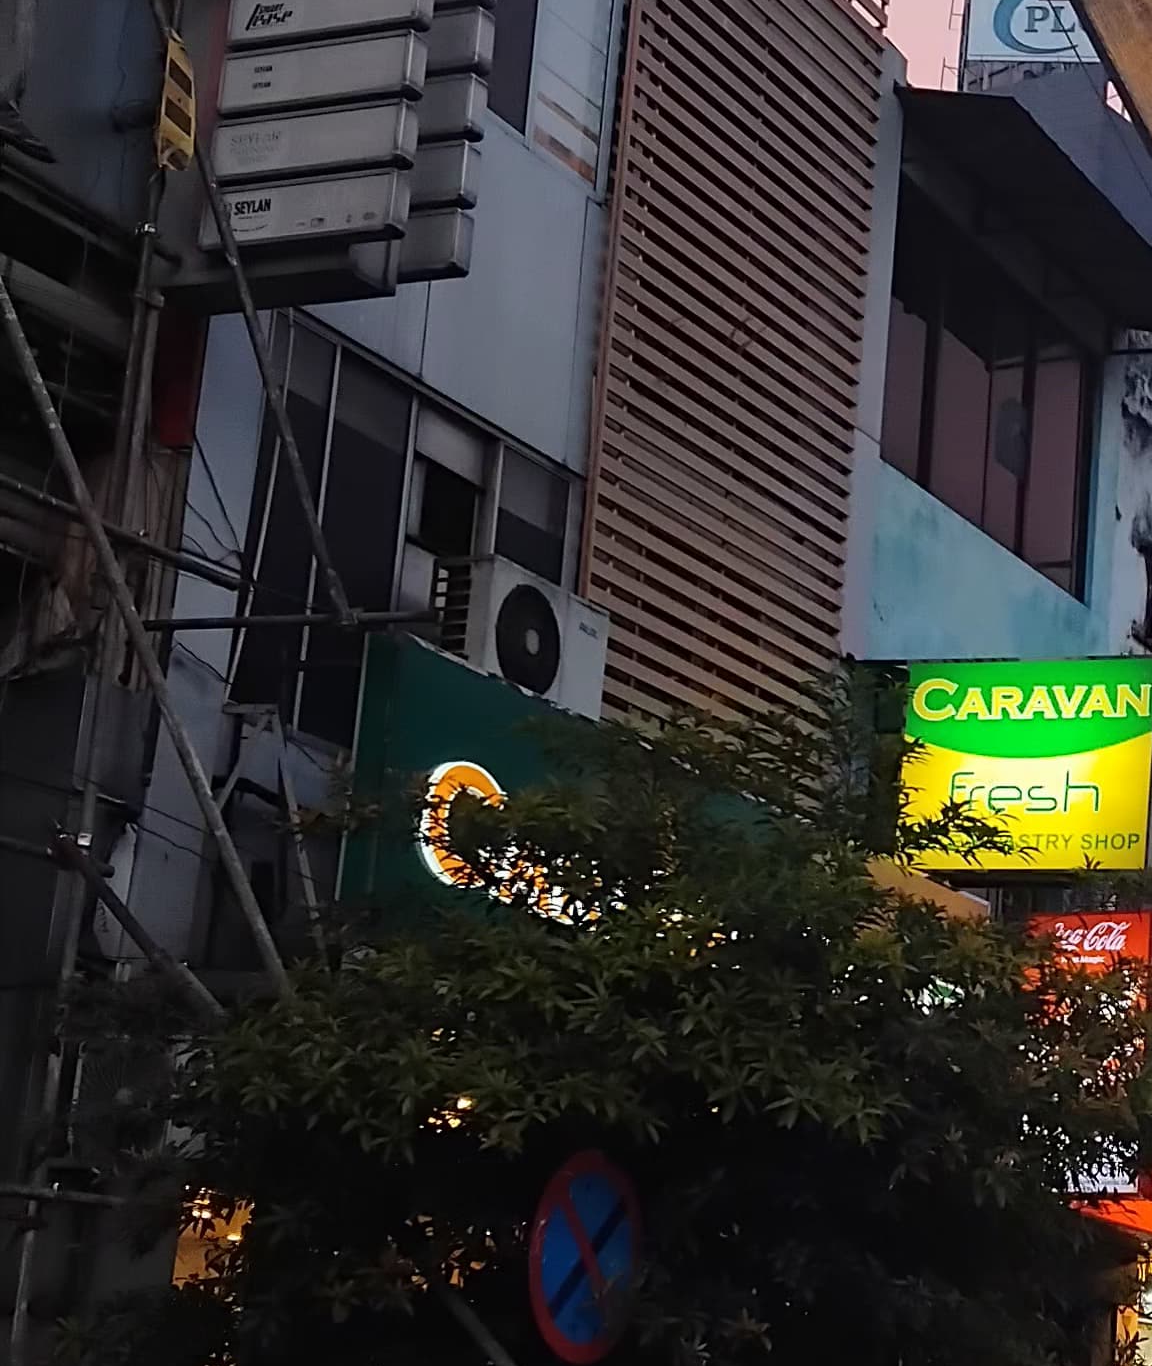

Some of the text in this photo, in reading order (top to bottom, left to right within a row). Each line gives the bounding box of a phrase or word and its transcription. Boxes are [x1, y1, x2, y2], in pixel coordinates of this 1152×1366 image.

[1024, 6, 1075, 33] PL
[234, 199, 272, 216] SEYLAN
[913, 678, 1151, 721] CARAVAN
[1081, 832, 1140, 852] SHOP
